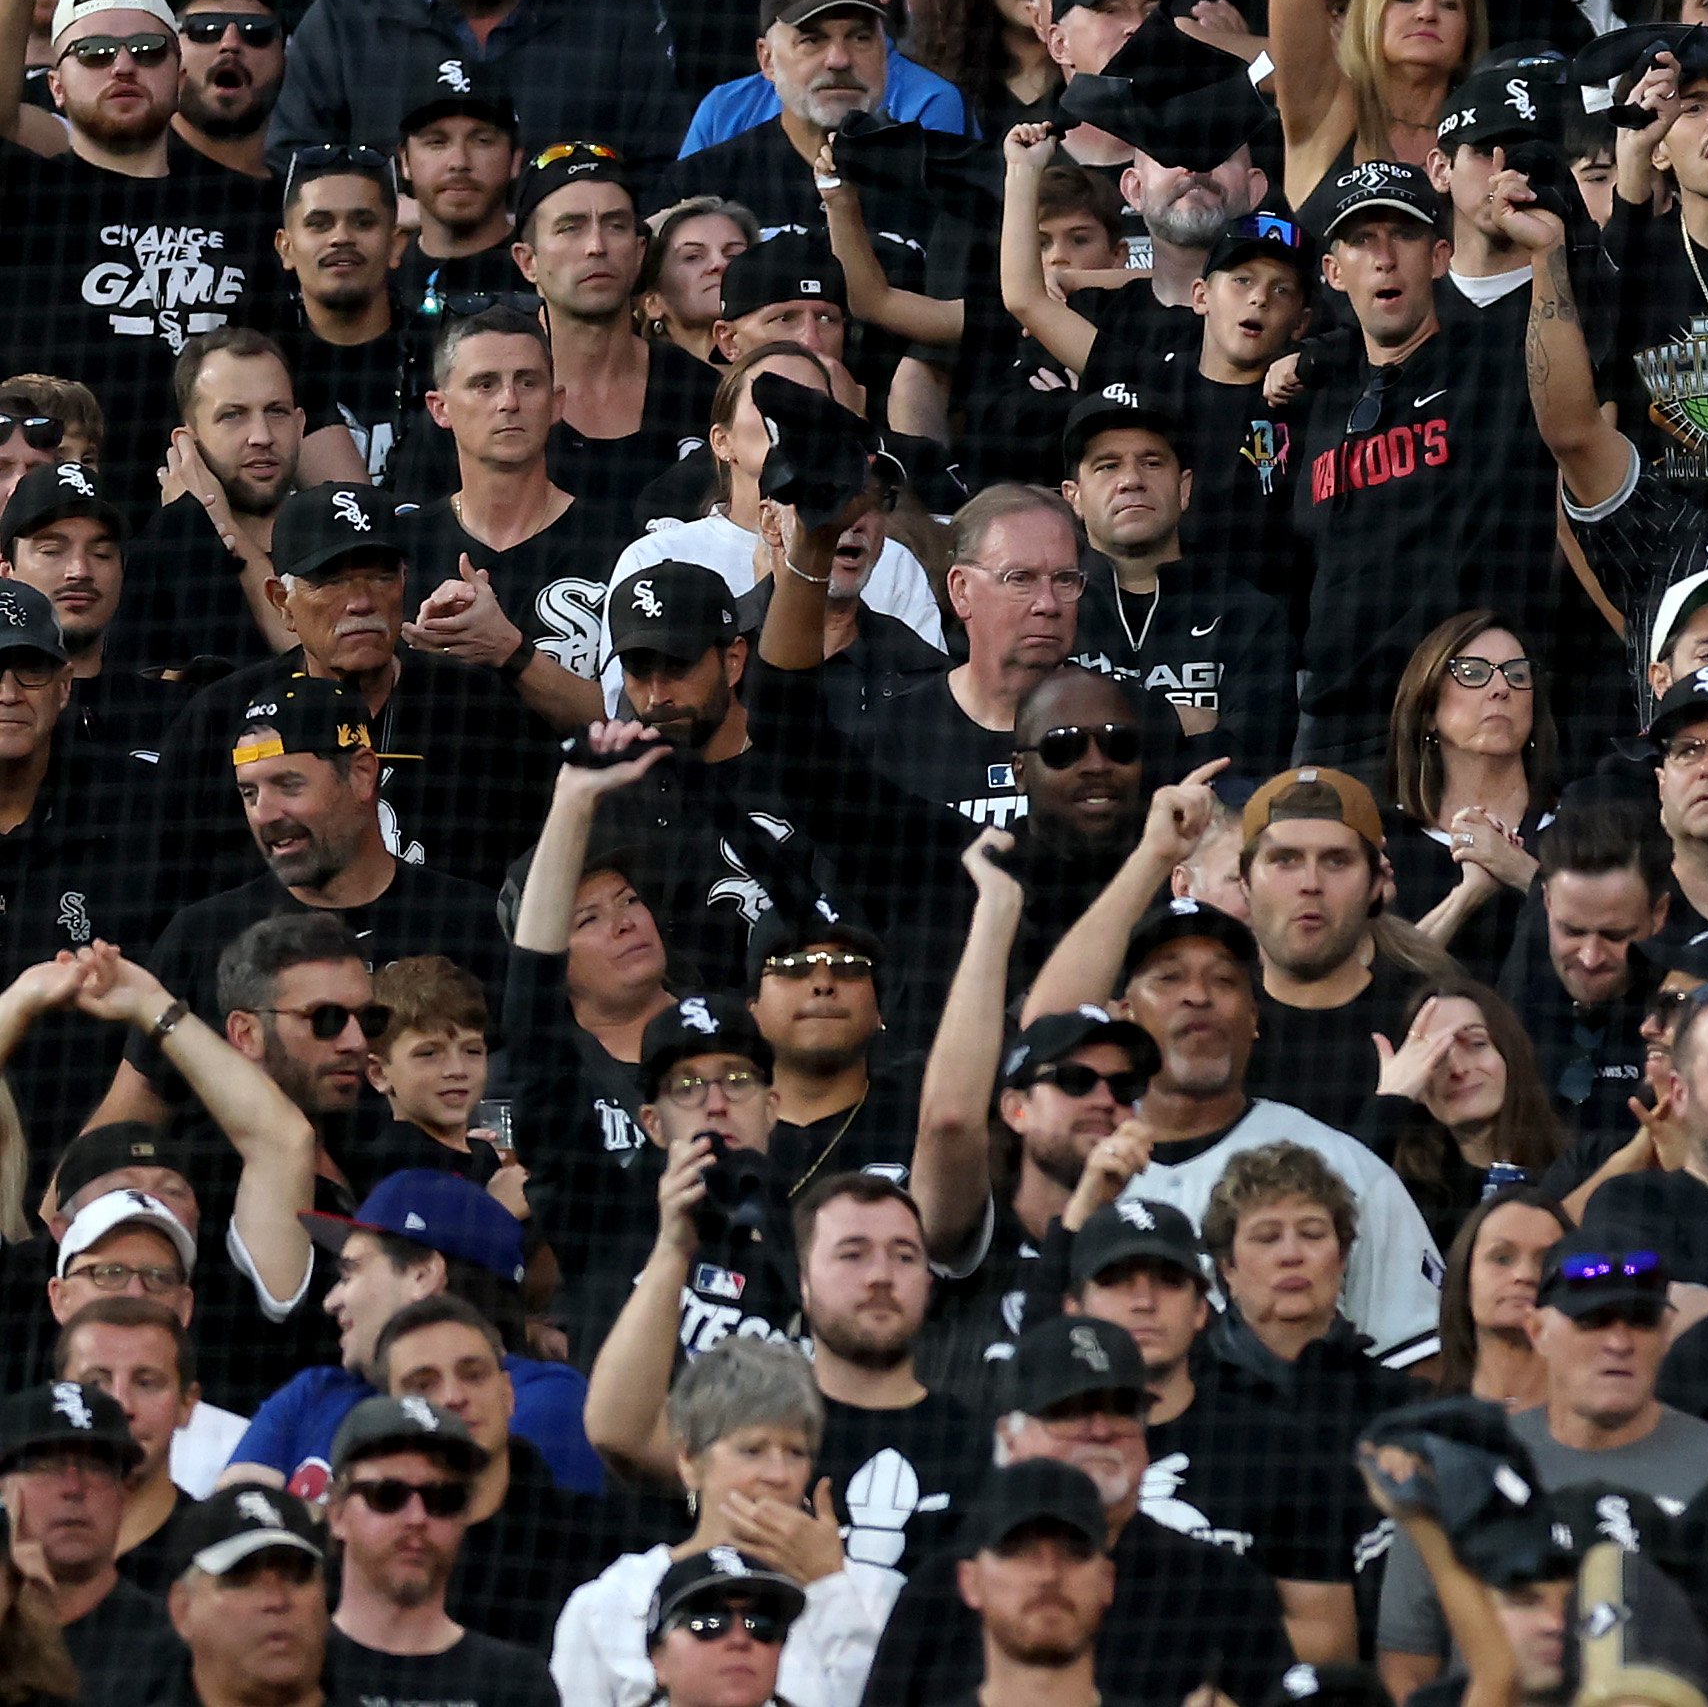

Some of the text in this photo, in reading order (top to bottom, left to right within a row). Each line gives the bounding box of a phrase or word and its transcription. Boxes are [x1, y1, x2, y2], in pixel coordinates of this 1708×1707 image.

[437, 60, 471, 93] Sox
[1505, 78, 1537, 121] Sox
[1337, 162, 1412, 188] Chicago
[100, 223, 225, 250] CHANGE
[141, 245, 188, 266] THE
[81, 262, 246, 310] GAME
[1102, 383, 1138, 409] Chi
[57, 463, 95, 496] Sox
[333, 491, 371, 532] Sox
[631, 580, 663, 617] Sox
